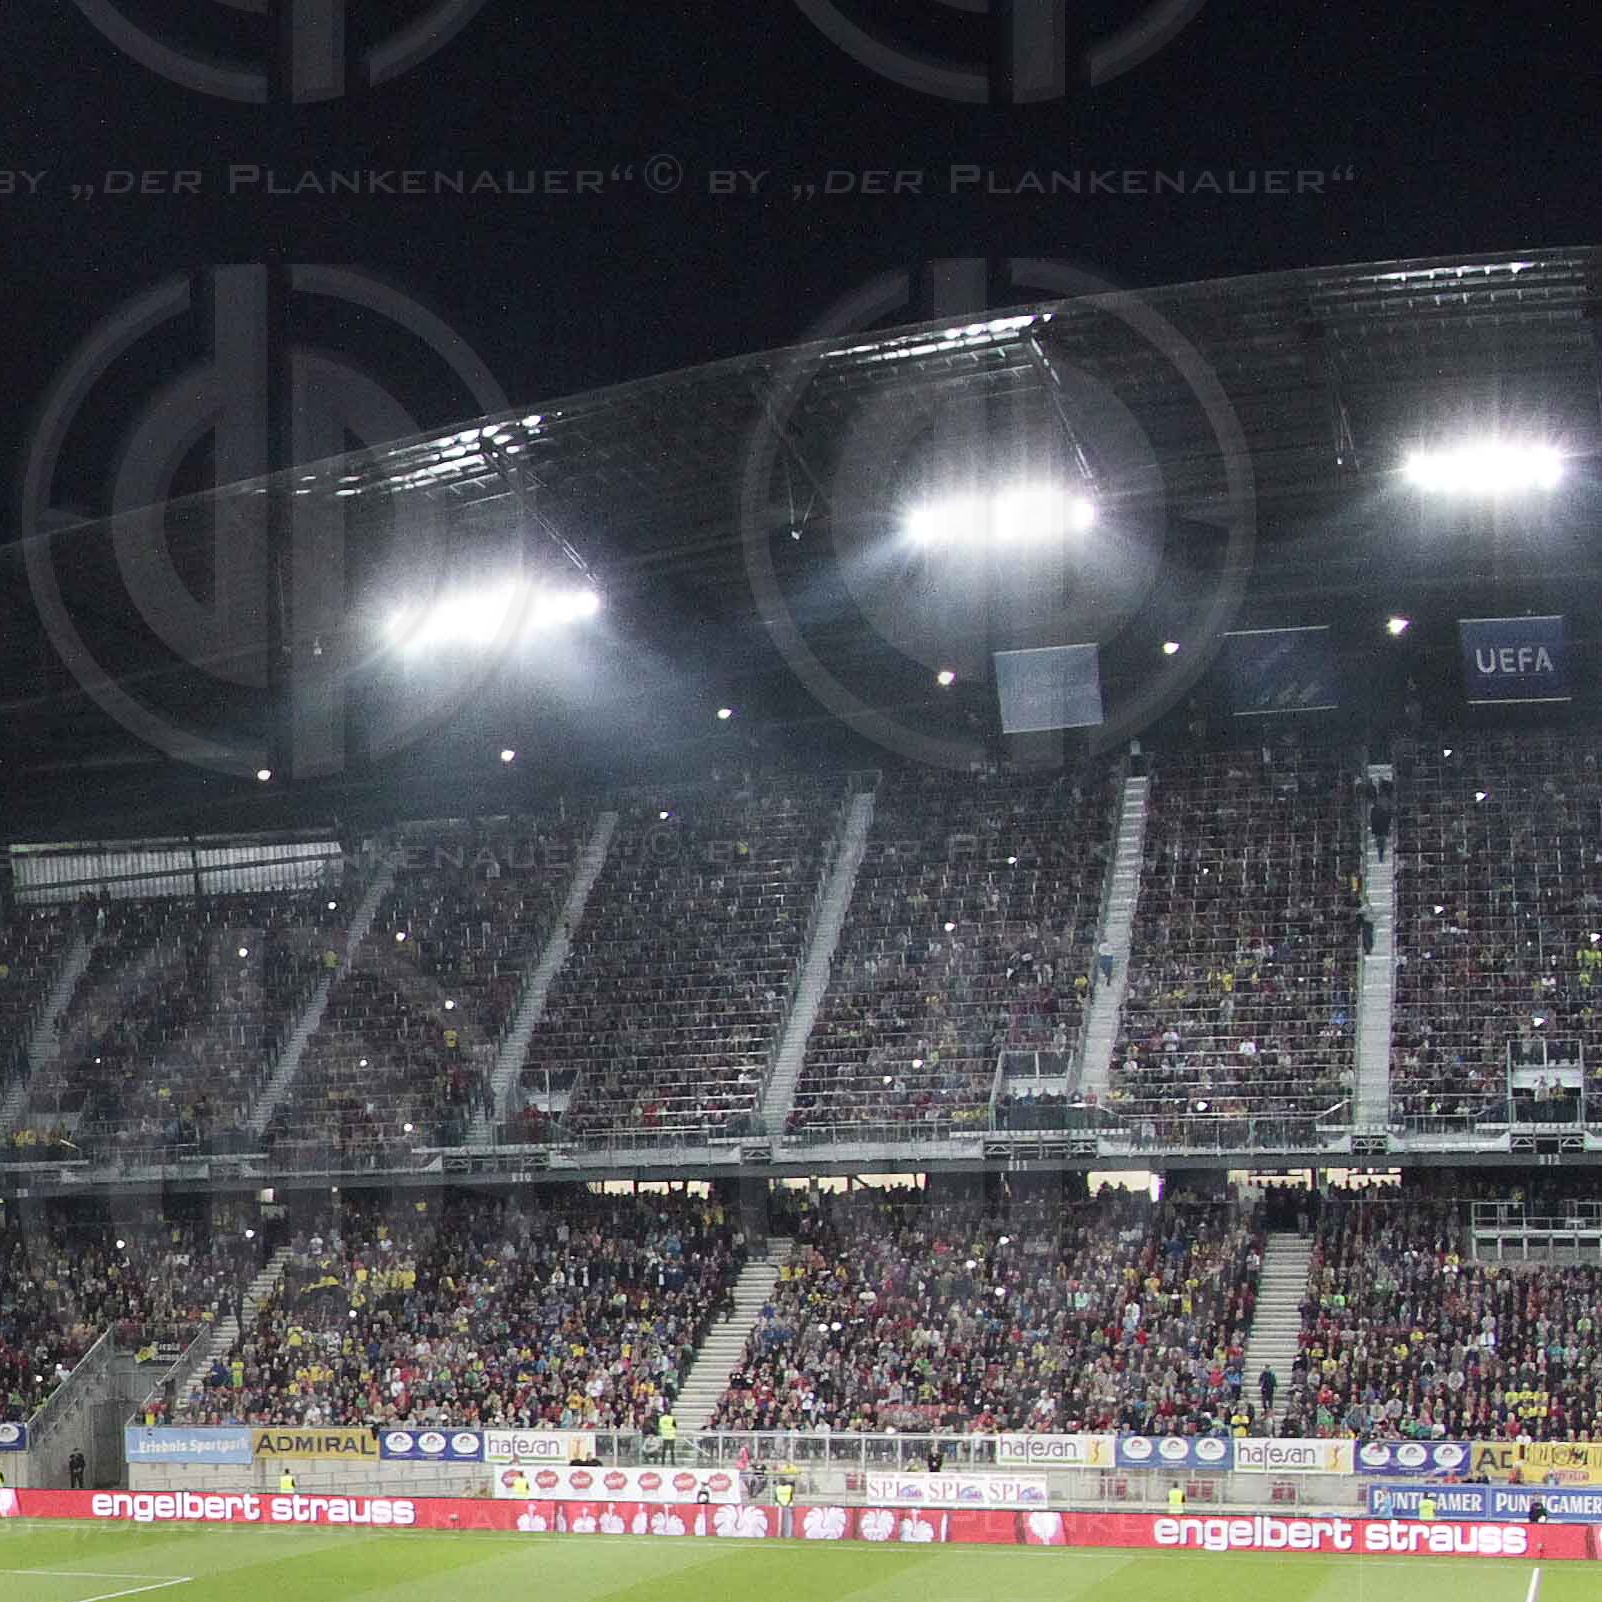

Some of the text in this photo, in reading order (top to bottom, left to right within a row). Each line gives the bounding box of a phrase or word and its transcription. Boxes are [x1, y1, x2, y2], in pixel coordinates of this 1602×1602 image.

[1476, 647, 1555, 673] UEFA
[256, 1433, 377, 1456] ADMIRAL
[488, 1434, 561, 1458] hafesan
[999, 1436, 1078, 1464] hafesan
[1238, 1442, 1317, 1468] hafesan
[92, 1490, 415, 1525] engelbert strauss
[1154, 1516, 1527, 1556] engelbert strauss
